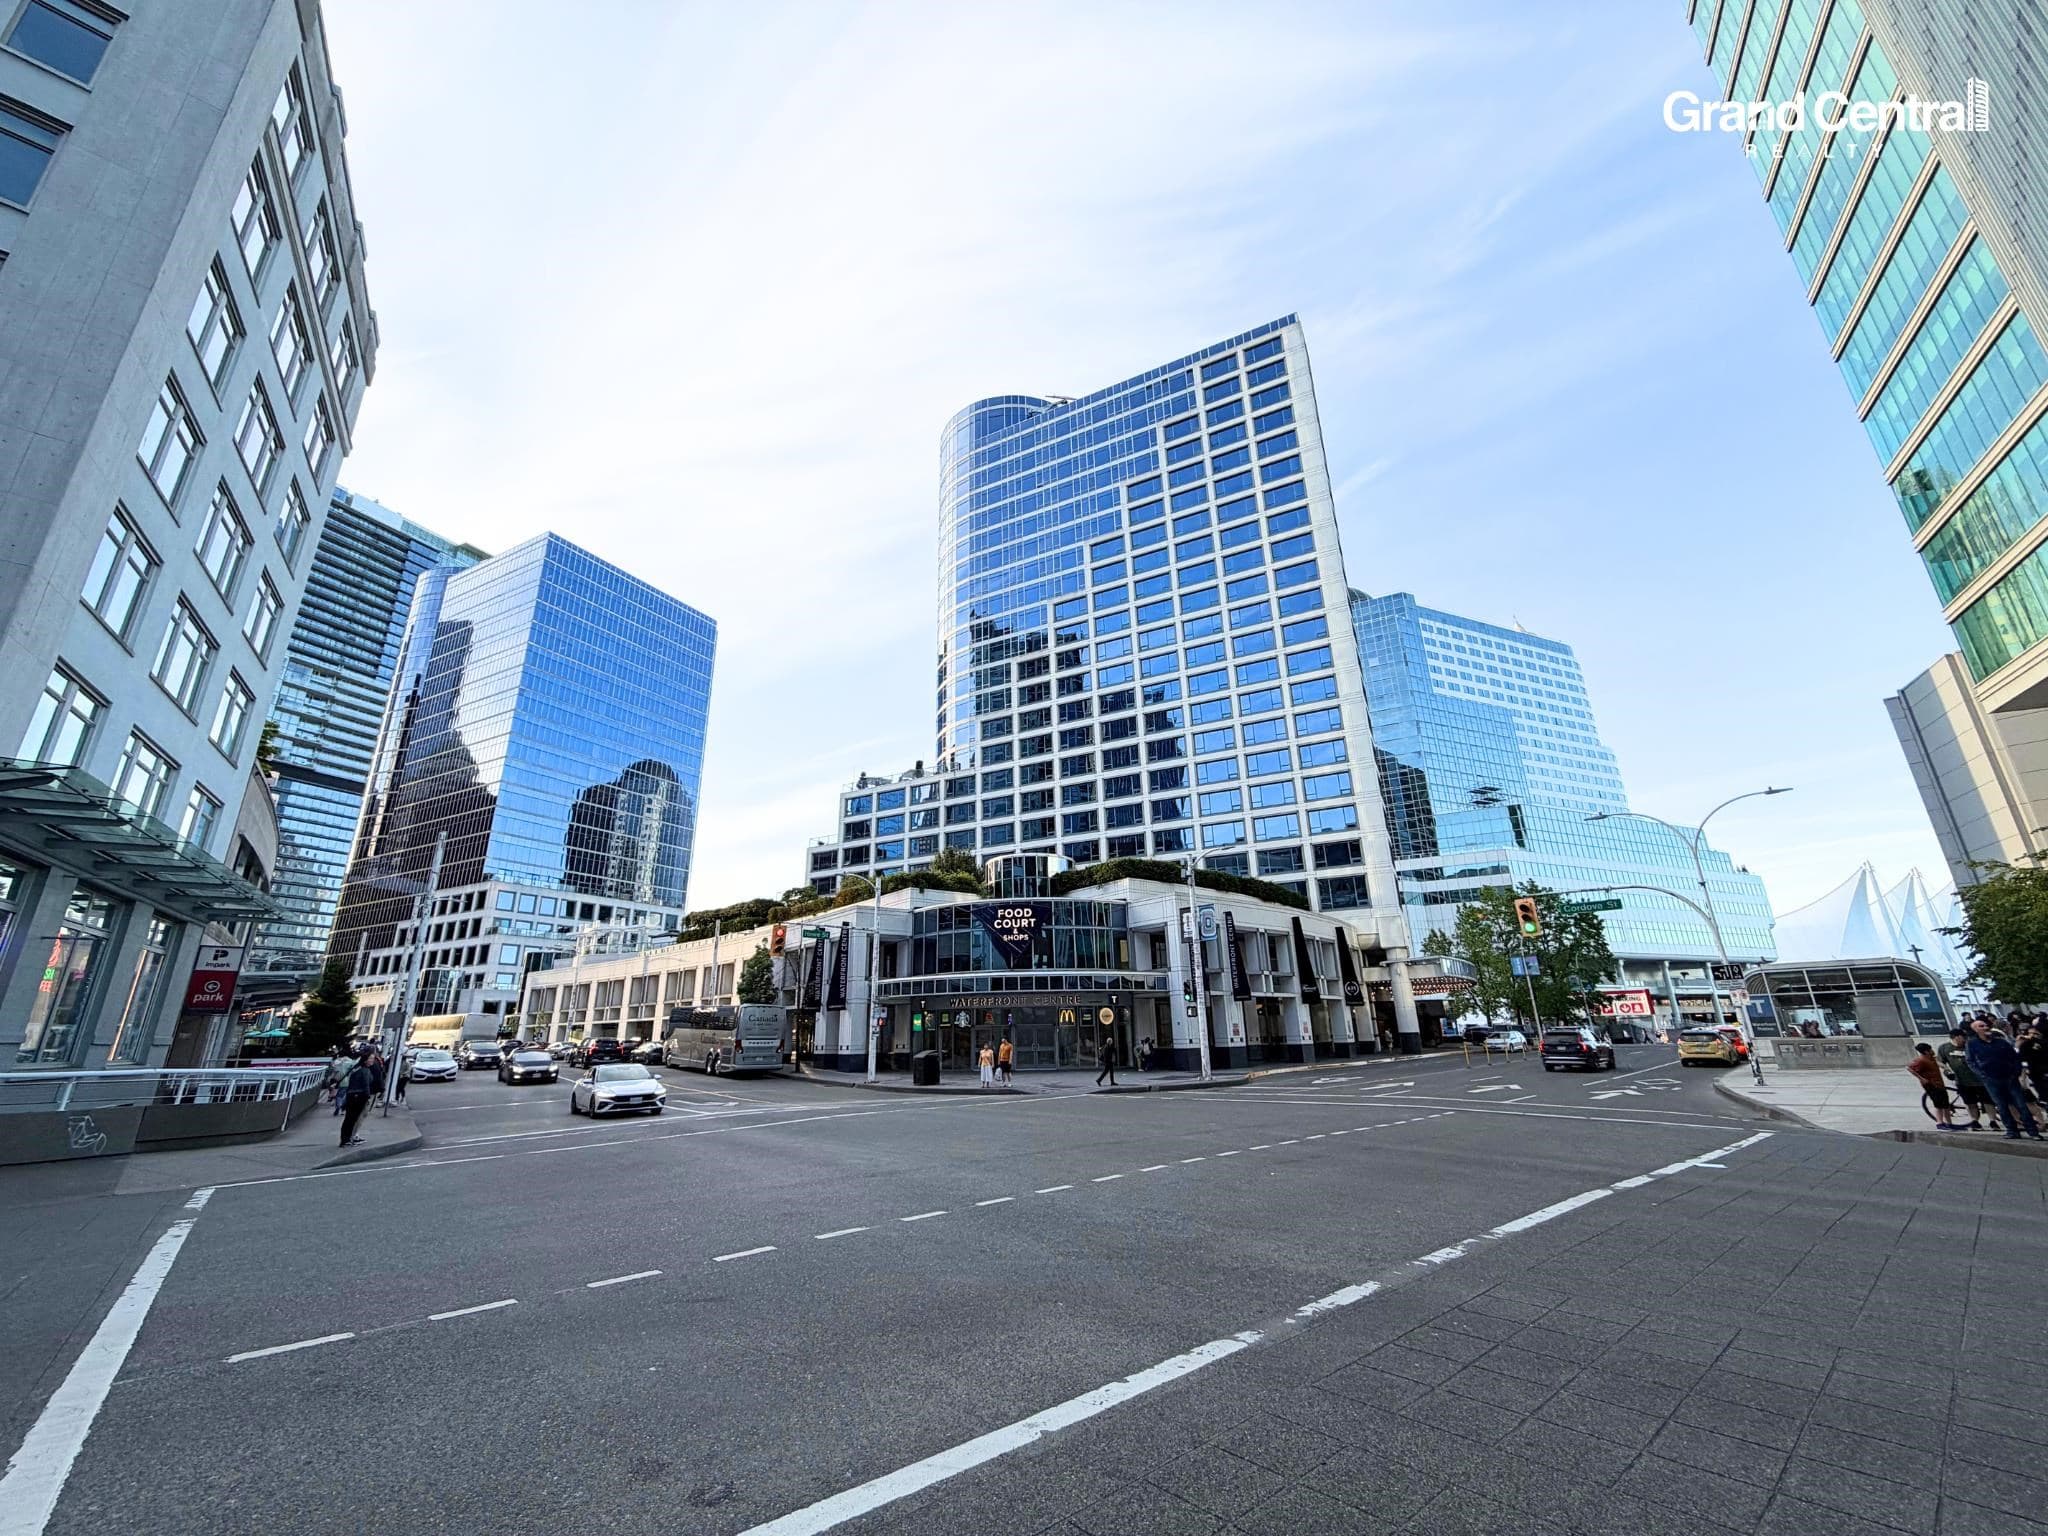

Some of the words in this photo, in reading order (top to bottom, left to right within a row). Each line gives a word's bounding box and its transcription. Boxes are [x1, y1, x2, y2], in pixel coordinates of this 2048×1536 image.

[1563, 903, 1603, 913] Cordova
[1606, 901, 1618, 909] St
[998, 908, 1032, 918] FOOD
[994, 918, 1036, 928] COURT
[1229, 944, 1239, 989] WATERFRONT
[193, 992, 223, 1003] park
[950, 996, 1027, 1008] WATERFRONT
[1033, 995, 1080, 1005] CENTRE
[748, 1014, 778, 1023] Canada
